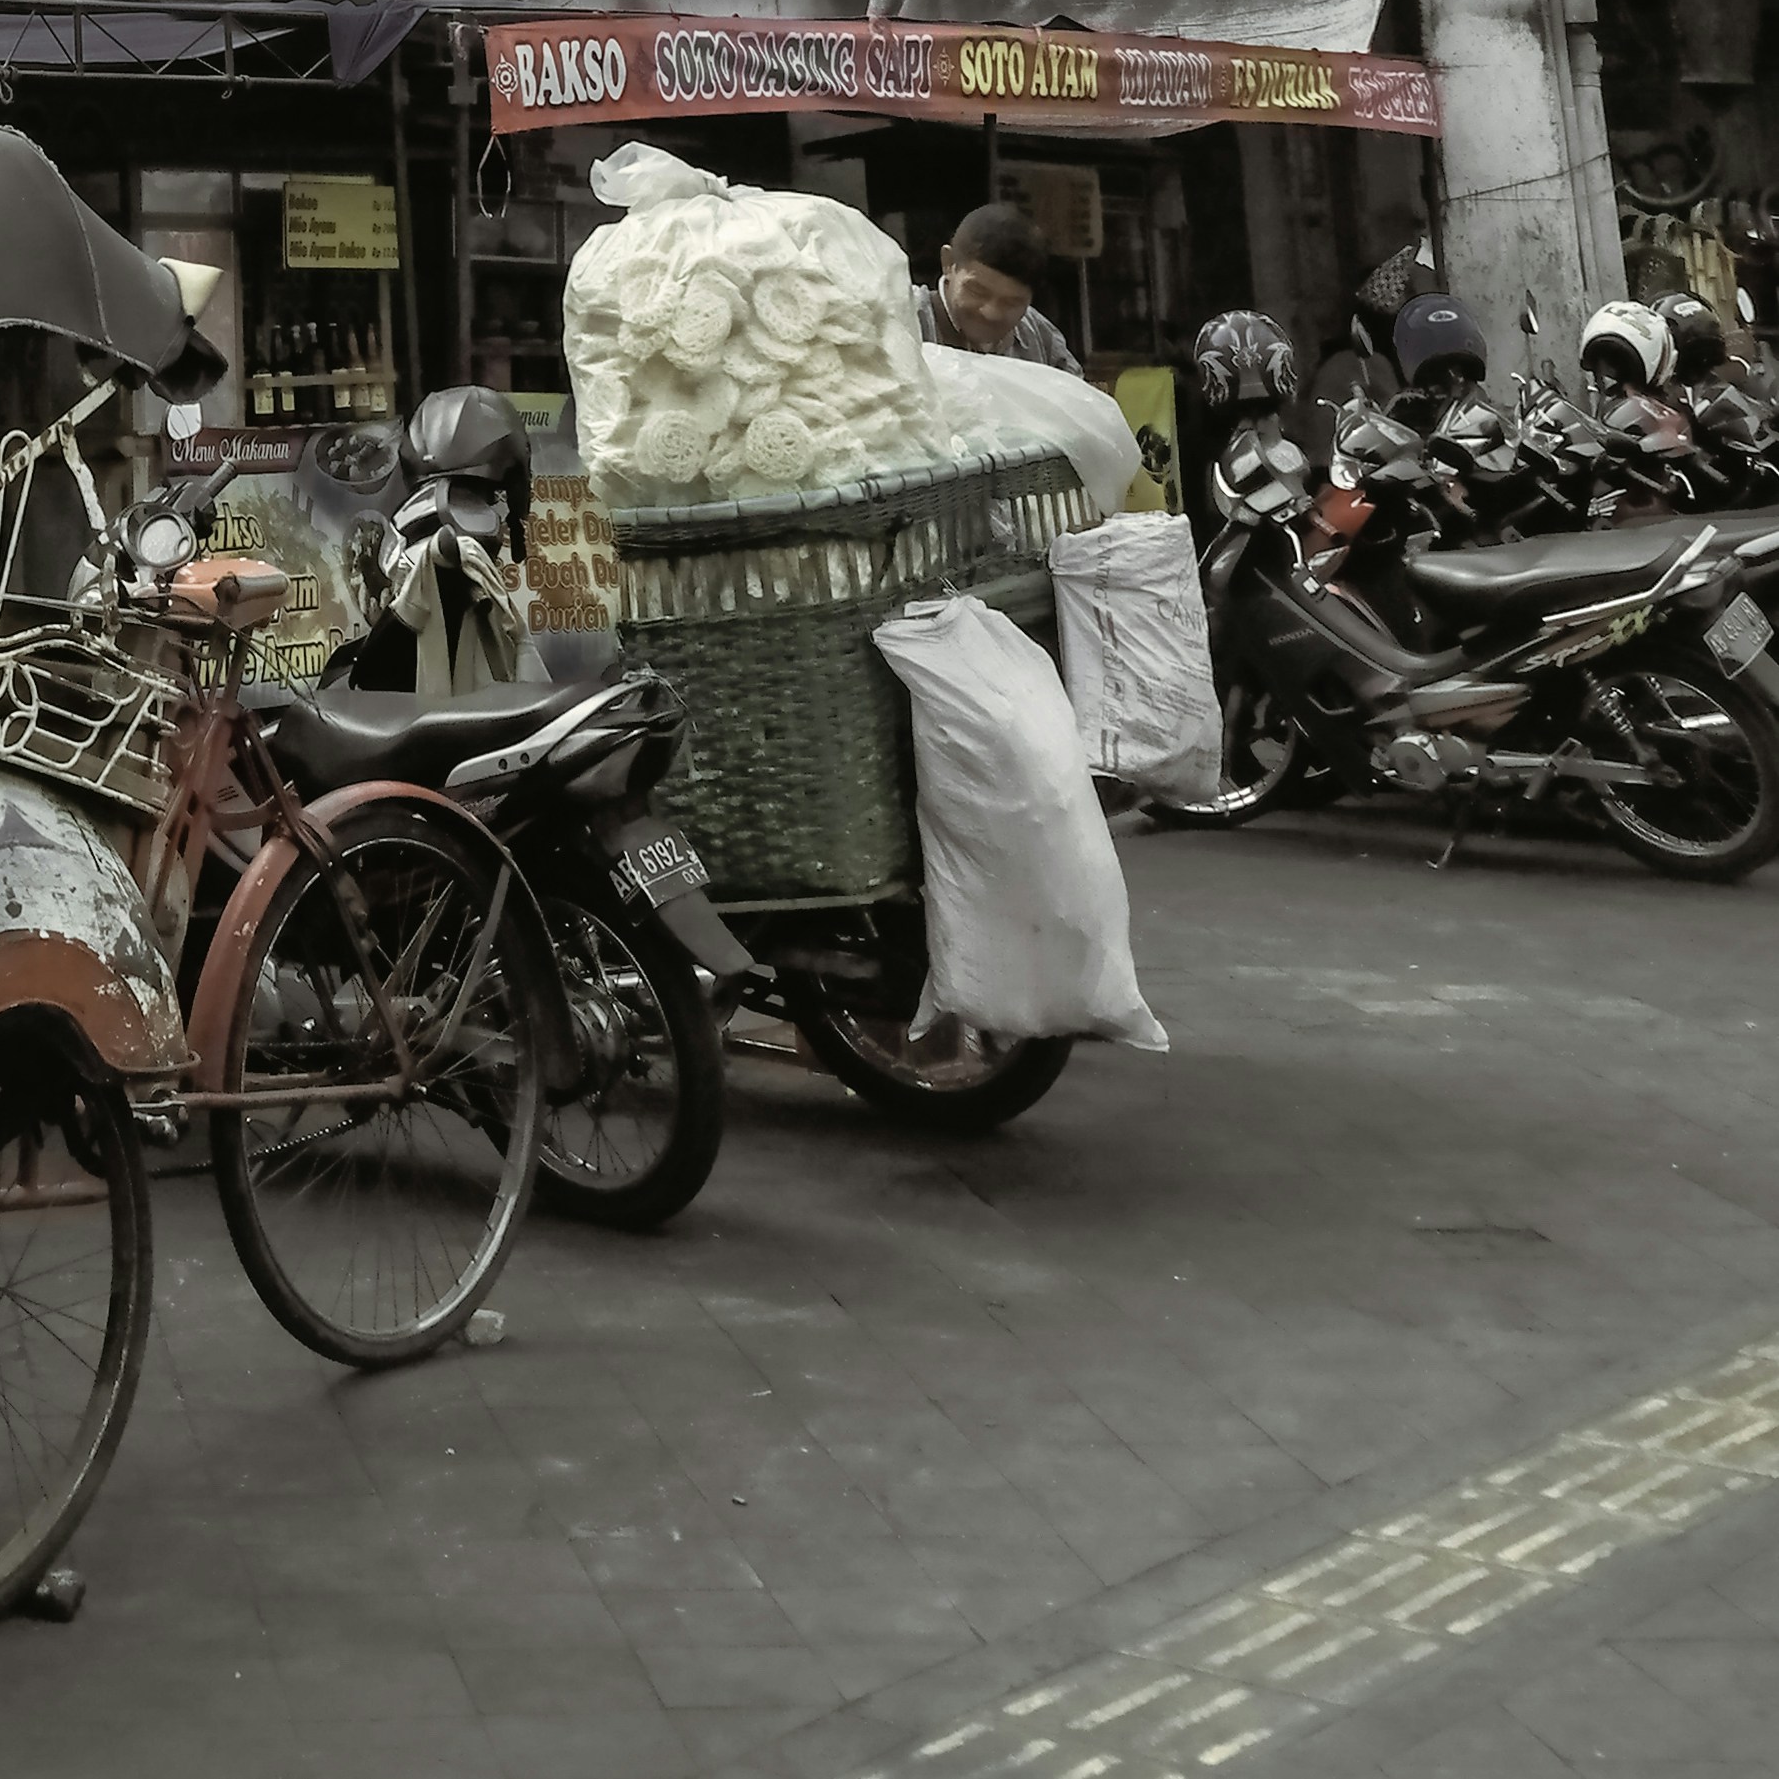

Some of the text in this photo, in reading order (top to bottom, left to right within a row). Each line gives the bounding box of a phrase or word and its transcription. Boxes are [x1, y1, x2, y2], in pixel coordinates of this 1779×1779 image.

[515, 38, 627, 108] BAKSO
[654, 30, 738, 102] SOTO
[739, 31, 859, 98] DAGING
[865, 33, 933, 99] SAPI
[959, 38, 1025, 97] SOTO
[1029, 42, 1099, 100] AYAM
[1230, 57, 1257, 109] ES
[1256, 58, 1342, 111] DURIAN
[172, 435, 291, 462] Menu Makanan
[198, 502, 266, 553] akso
[524, 508, 579, 547] Teler
[525, 551, 591, 591] Buah
[527, 596, 610, 637] Durian
[261, 634, 326, 690] Ayam
[639, 836, 684, 874] 6192
